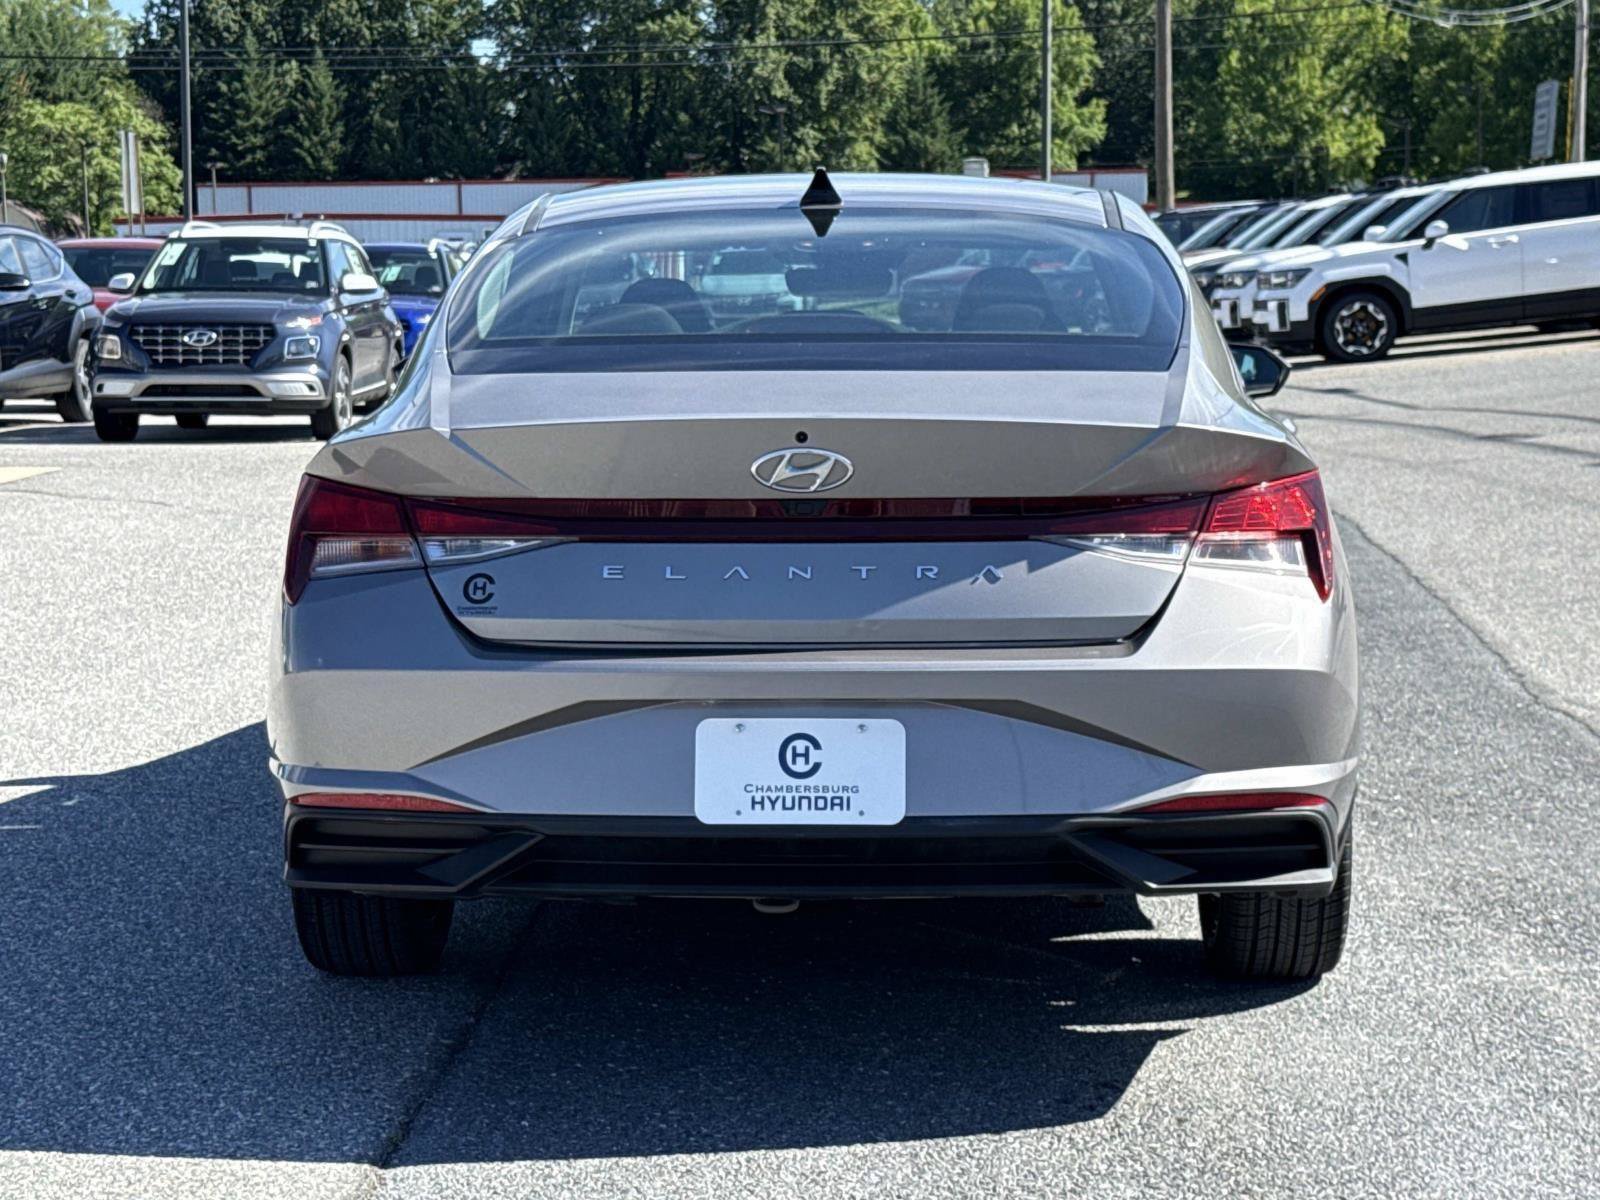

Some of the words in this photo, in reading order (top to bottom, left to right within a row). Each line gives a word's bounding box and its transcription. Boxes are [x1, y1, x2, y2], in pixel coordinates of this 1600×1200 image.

[602, 565, 1004, 580] ELANTRA
[743, 783, 860, 794] CHAMBERSBURG
[751, 795, 851, 812] HYUNDAI
